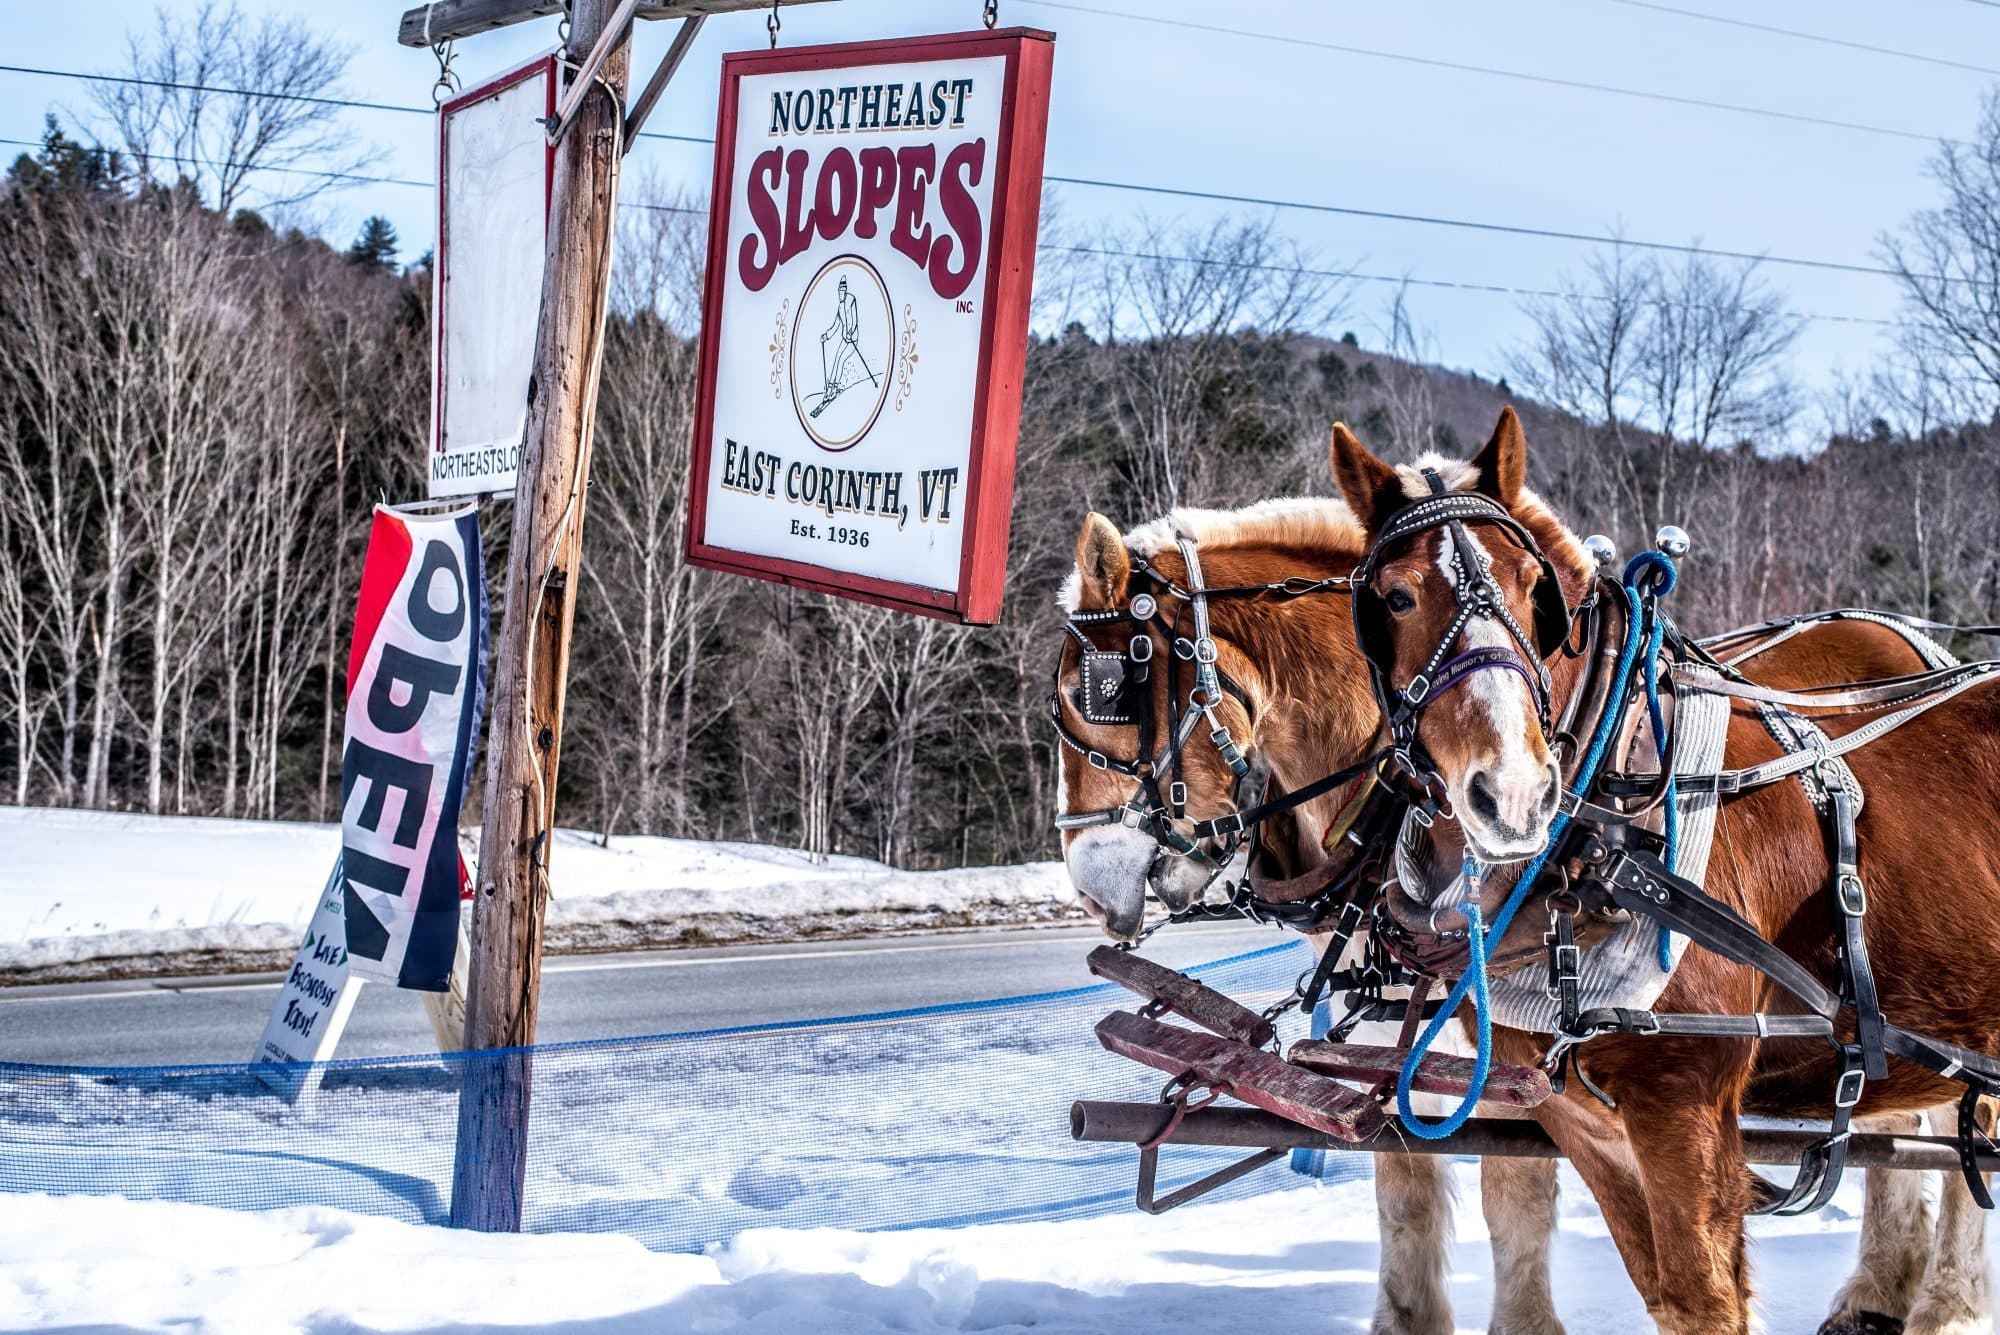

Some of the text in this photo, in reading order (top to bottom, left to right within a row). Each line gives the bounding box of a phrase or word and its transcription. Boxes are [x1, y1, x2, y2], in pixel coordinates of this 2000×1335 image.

[769, 78, 973, 135] NORTHEAST
[738, 137, 985, 300] SLOPES
[721, 437, 958, 530] EAST CORINTH, VT
[790, 519, 870, 548] Est. 1936
